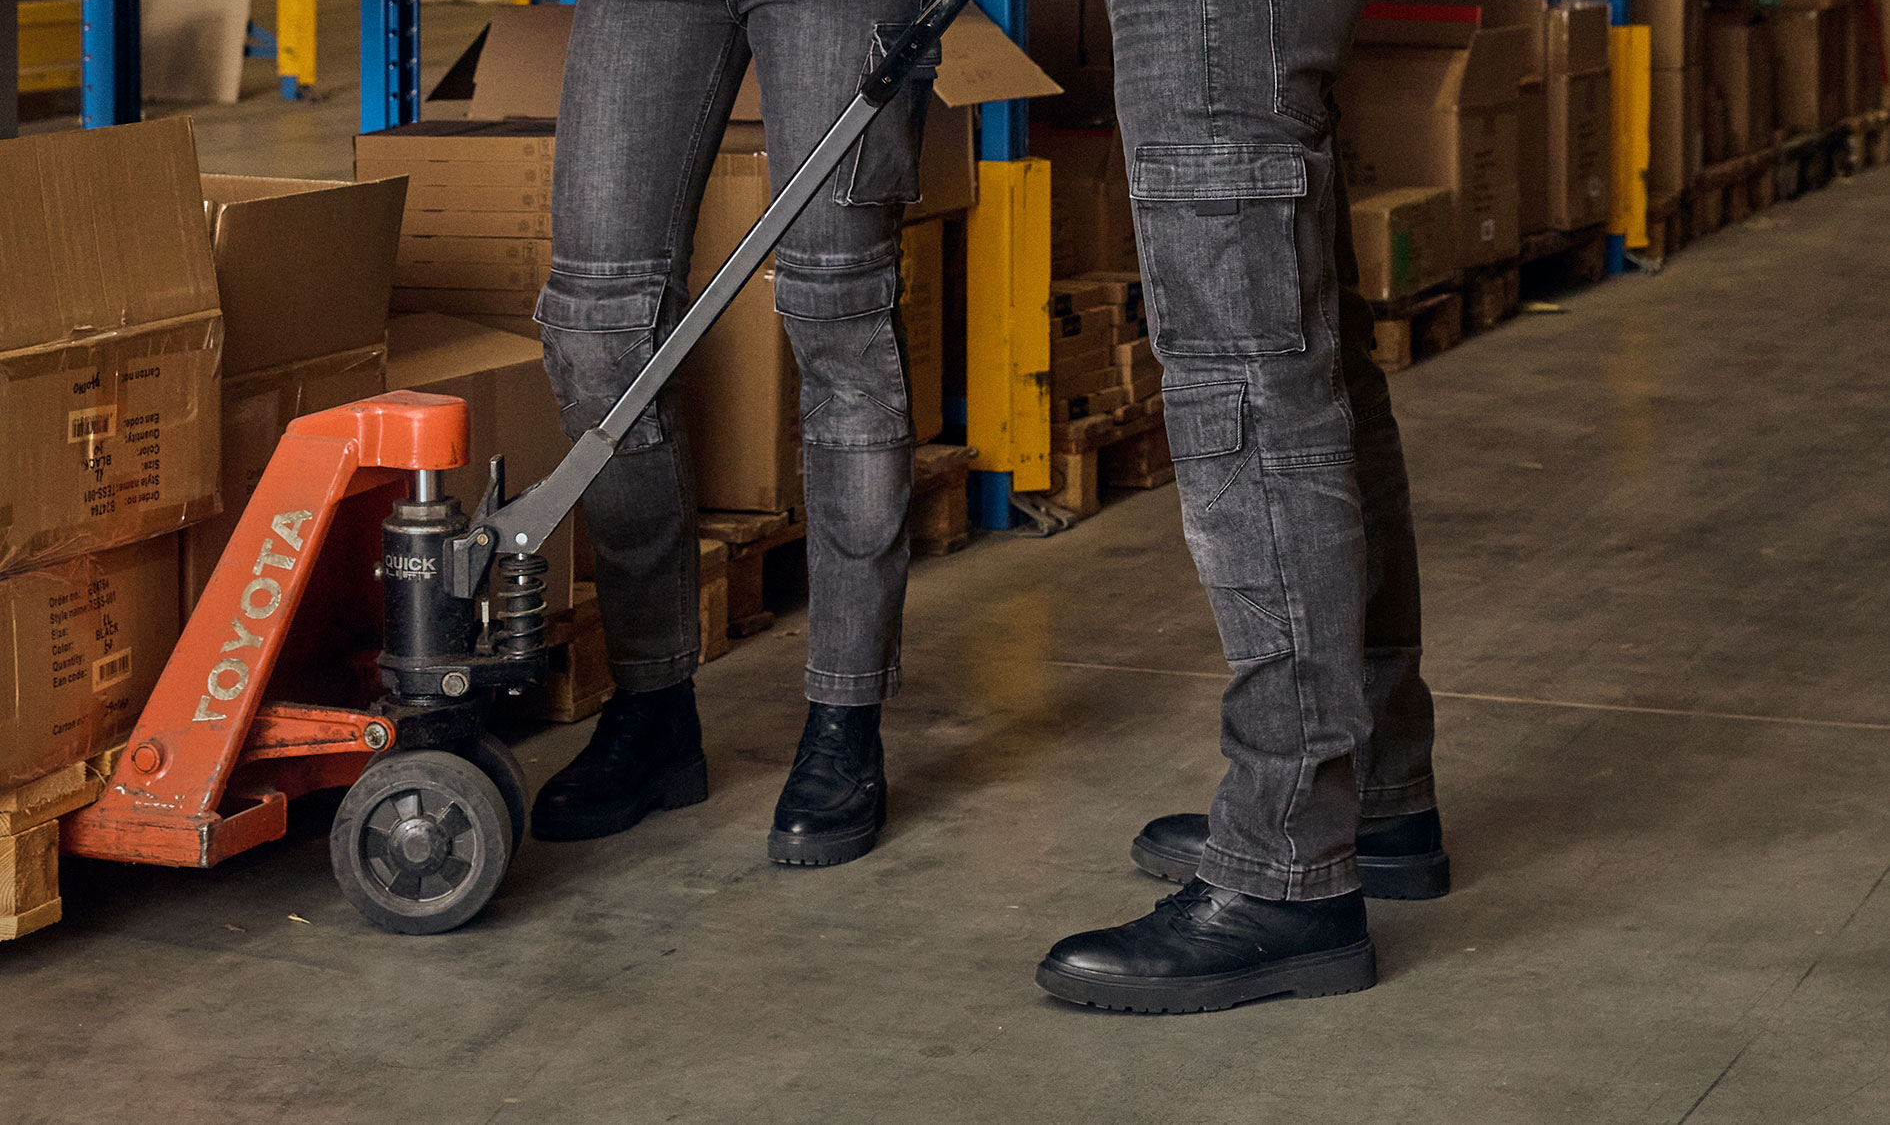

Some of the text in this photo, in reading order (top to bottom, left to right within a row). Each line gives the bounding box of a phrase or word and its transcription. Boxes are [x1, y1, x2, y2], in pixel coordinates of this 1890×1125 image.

[135, 366, 161, 381] Carton
[144, 412, 160, 424] Ean
[125, 428, 160, 444] Quantity:
[83, 443, 160, 472] Color: BLACK
[141, 459, 160, 470] Size:
[141, 473, 160, 488] Style
[139, 490, 160, 502] Order
[385, 554, 437, 572] QUICK
[48, 594, 69, 609] Order
[50, 610, 68, 625] Style
[191, 509, 314, 723] TOYOTA
[51, 628, 69, 641] Size:
[52, 622, 120, 656] Color: BLACK
[53, 655, 86, 672] Quantity:
[53, 669, 88, 689] Ean code:
[52, 719, 77, 736] Carton
